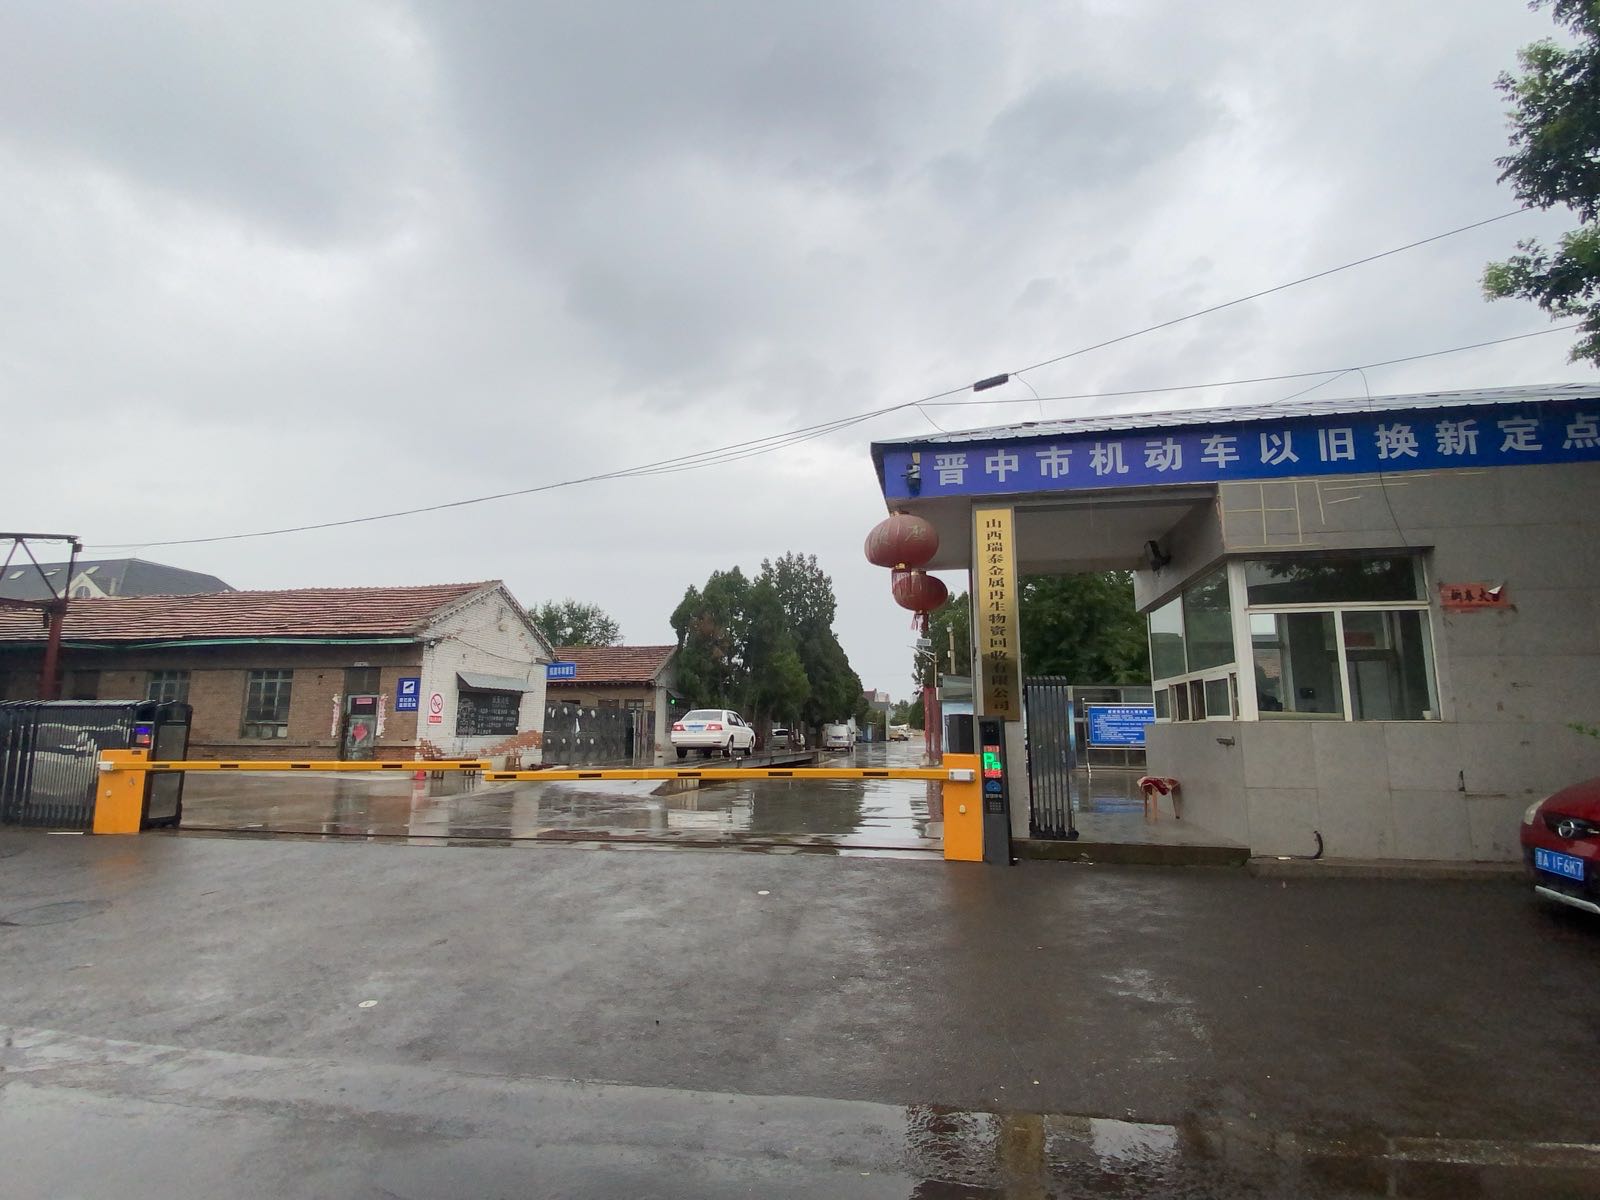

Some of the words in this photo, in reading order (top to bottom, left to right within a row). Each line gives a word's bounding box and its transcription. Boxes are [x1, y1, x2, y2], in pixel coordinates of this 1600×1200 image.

[934, 412, 1600, 486] 晋中市机动车以旧换新定点
[986, 518, 1009, 711] 山西瑞泰金属再生物资回收有限公司
